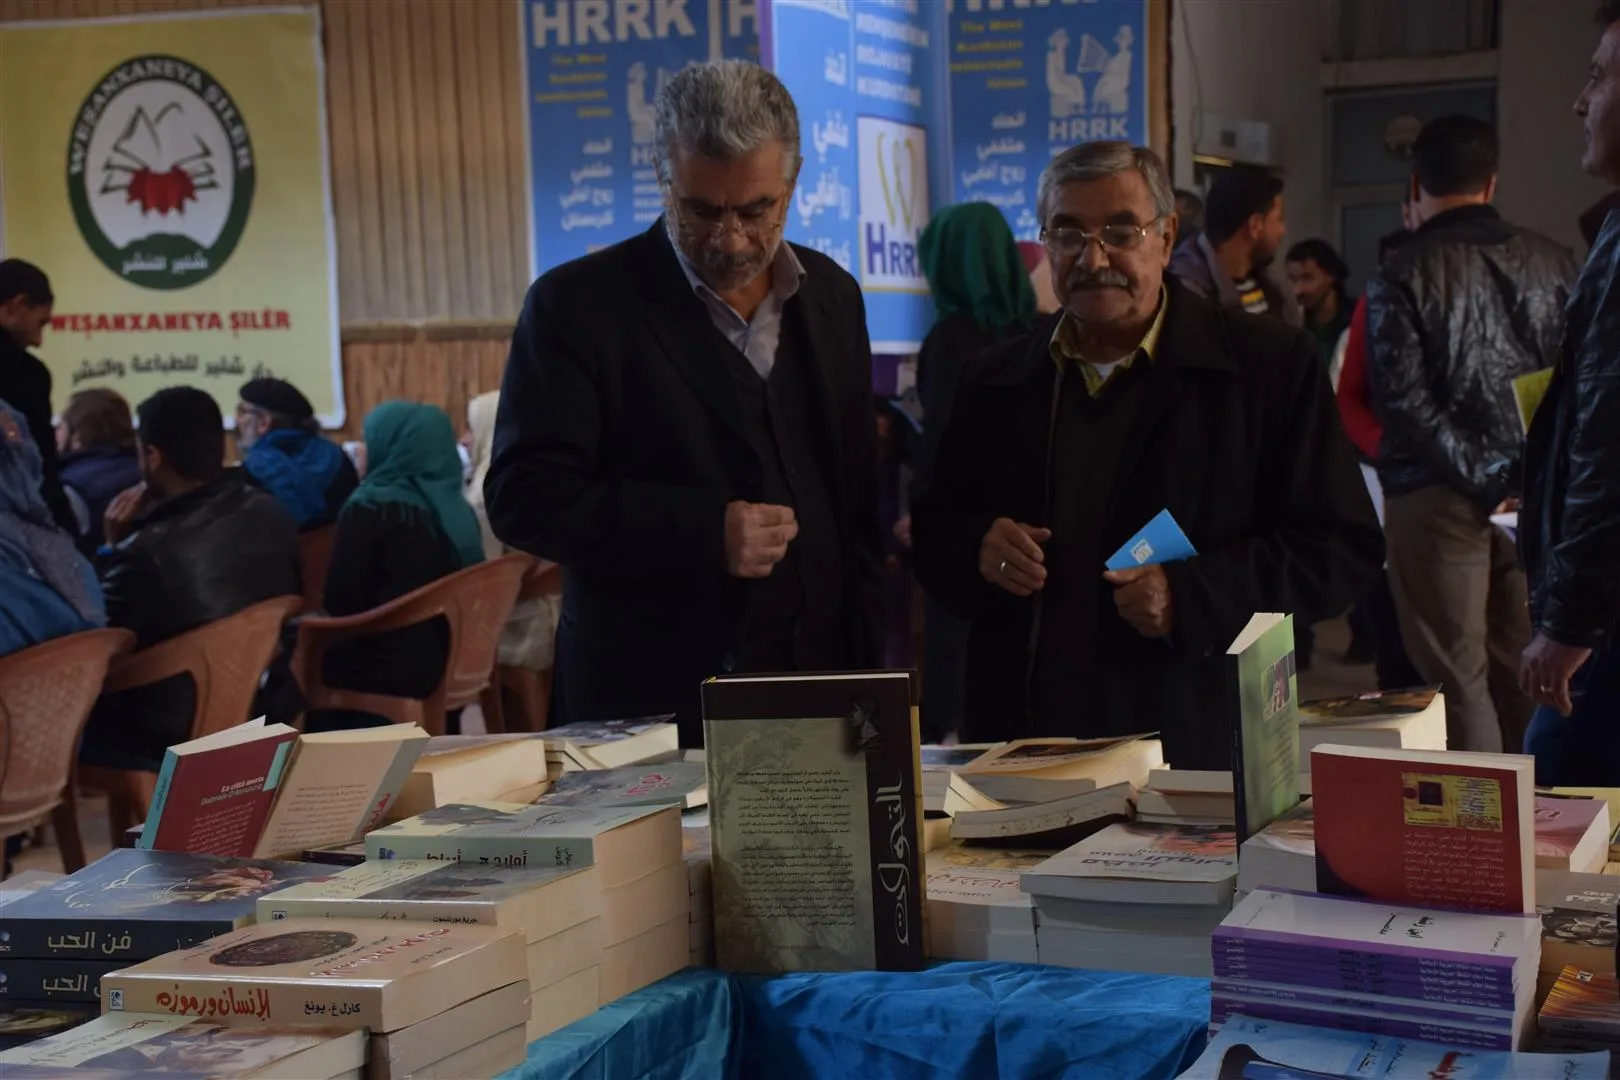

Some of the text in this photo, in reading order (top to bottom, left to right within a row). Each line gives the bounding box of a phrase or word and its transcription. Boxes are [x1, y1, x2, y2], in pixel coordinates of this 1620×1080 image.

[532, 0, 696, 49] HRRK
[1049, 117, 1129, 140] HRRK
[52, 312, 222, 340] WEŞANXANEYA
[72, 360, 126, 387] والنشر
[131, 354, 199, 376] للطباعة
[874, 770, 911, 946] التحولات
[47, 930, 132, 954] فن الحب
[42, 973, 88, 995] الحب
[304, 1001, 327, 1016] يونغ
[339, 1001, 361, 1015] كارل
